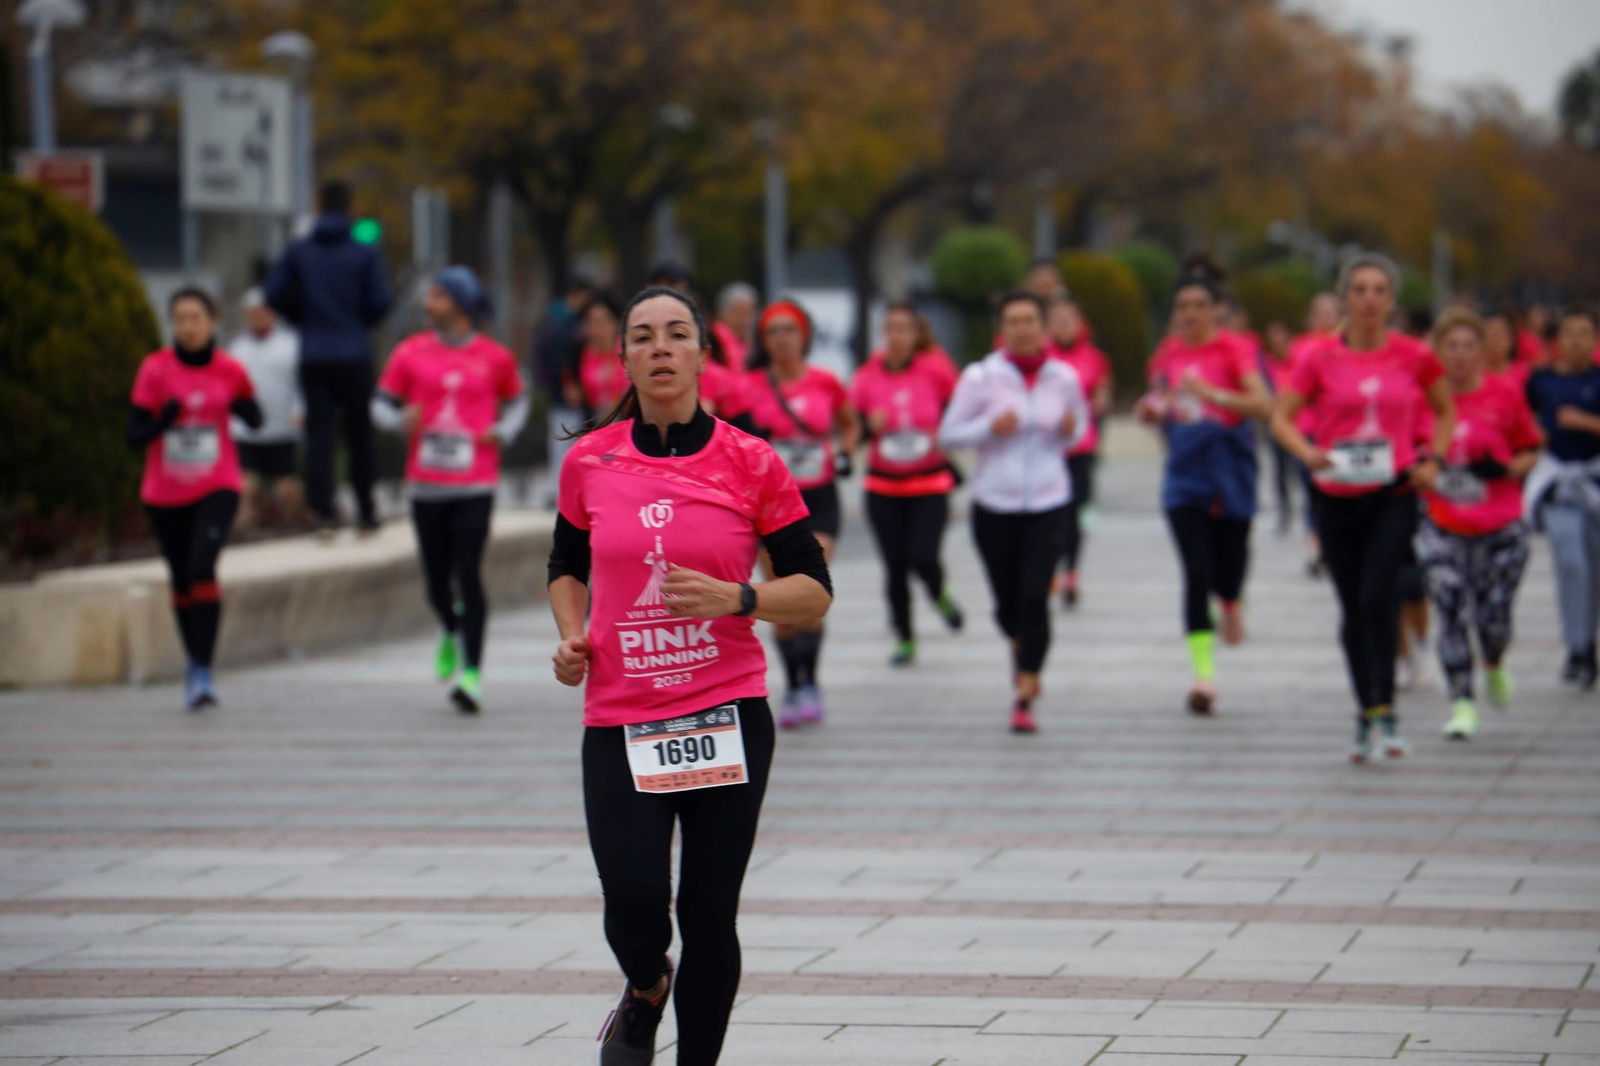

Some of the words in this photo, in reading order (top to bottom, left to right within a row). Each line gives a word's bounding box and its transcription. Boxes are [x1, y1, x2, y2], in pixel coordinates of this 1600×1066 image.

[618, 620, 717, 654] PINK
[622, 645, 719, 670] RUNNING
[653, 673, 693, 688] 2023
[653, 735, 716, 766] 1690
